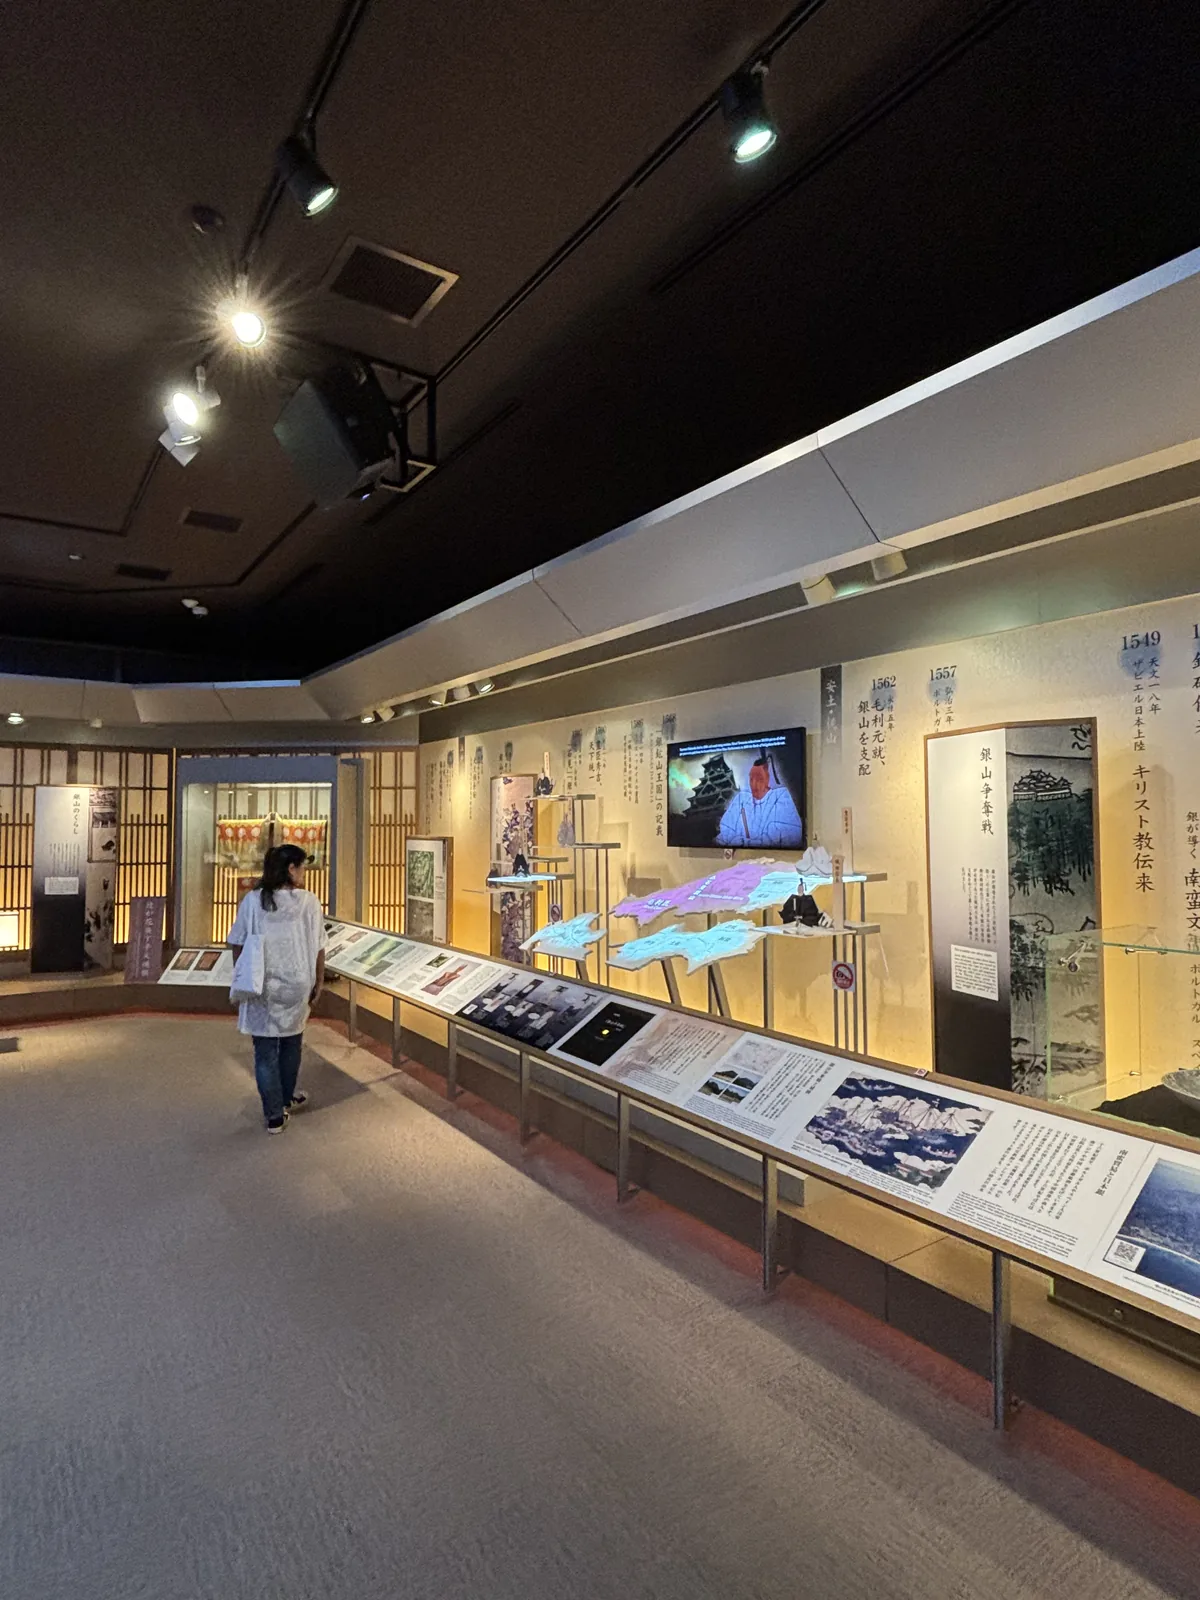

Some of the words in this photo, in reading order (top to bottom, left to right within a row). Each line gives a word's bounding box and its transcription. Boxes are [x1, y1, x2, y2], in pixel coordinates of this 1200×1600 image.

[1122, 630, 1161, 650] 1549
[872, 675, 896, 690] 1562
[930, 665, 957, 681] 1557
[1149, 656, 1161, 715] 天文一八年
[933, 688, 941, 733] ポルトガ
[1133, 659, 1146, 751] ザビエル日本上陸
[858, 700, 871, 776] 銀山を支配
[980, 747, 994, 835] 銀山争奪戦
[1133, 765, 1155, 893] キリスト教伝来
[1186, 811, 1200, 859] 銀が導く
